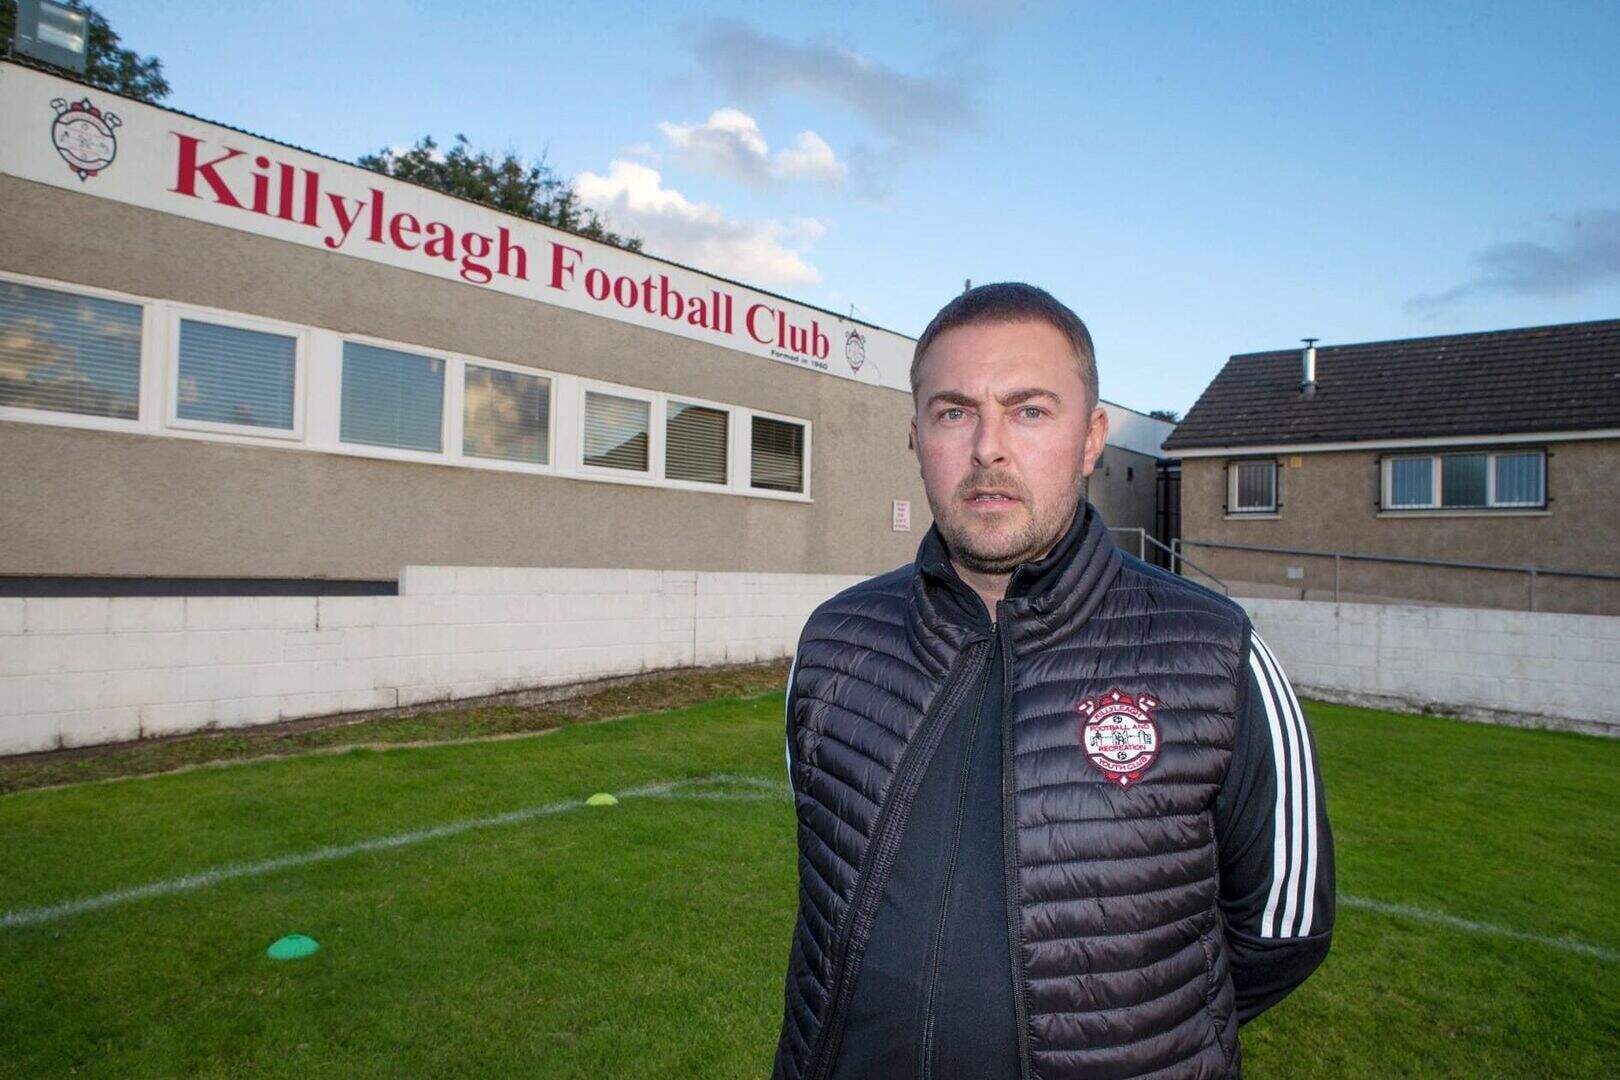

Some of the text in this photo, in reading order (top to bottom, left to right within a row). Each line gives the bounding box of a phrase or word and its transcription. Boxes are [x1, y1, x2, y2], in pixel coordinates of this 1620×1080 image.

[167, 131, 529, 284] Killyleagh
[545, 241, 733, 335] Football
[746, 303, 829, 359] Club
[771, 349, 799, 362] Formed
[1098, 744, 1146, 752] RECREATION
[1099, 756, 1148, 770] YOUTH CLUB
